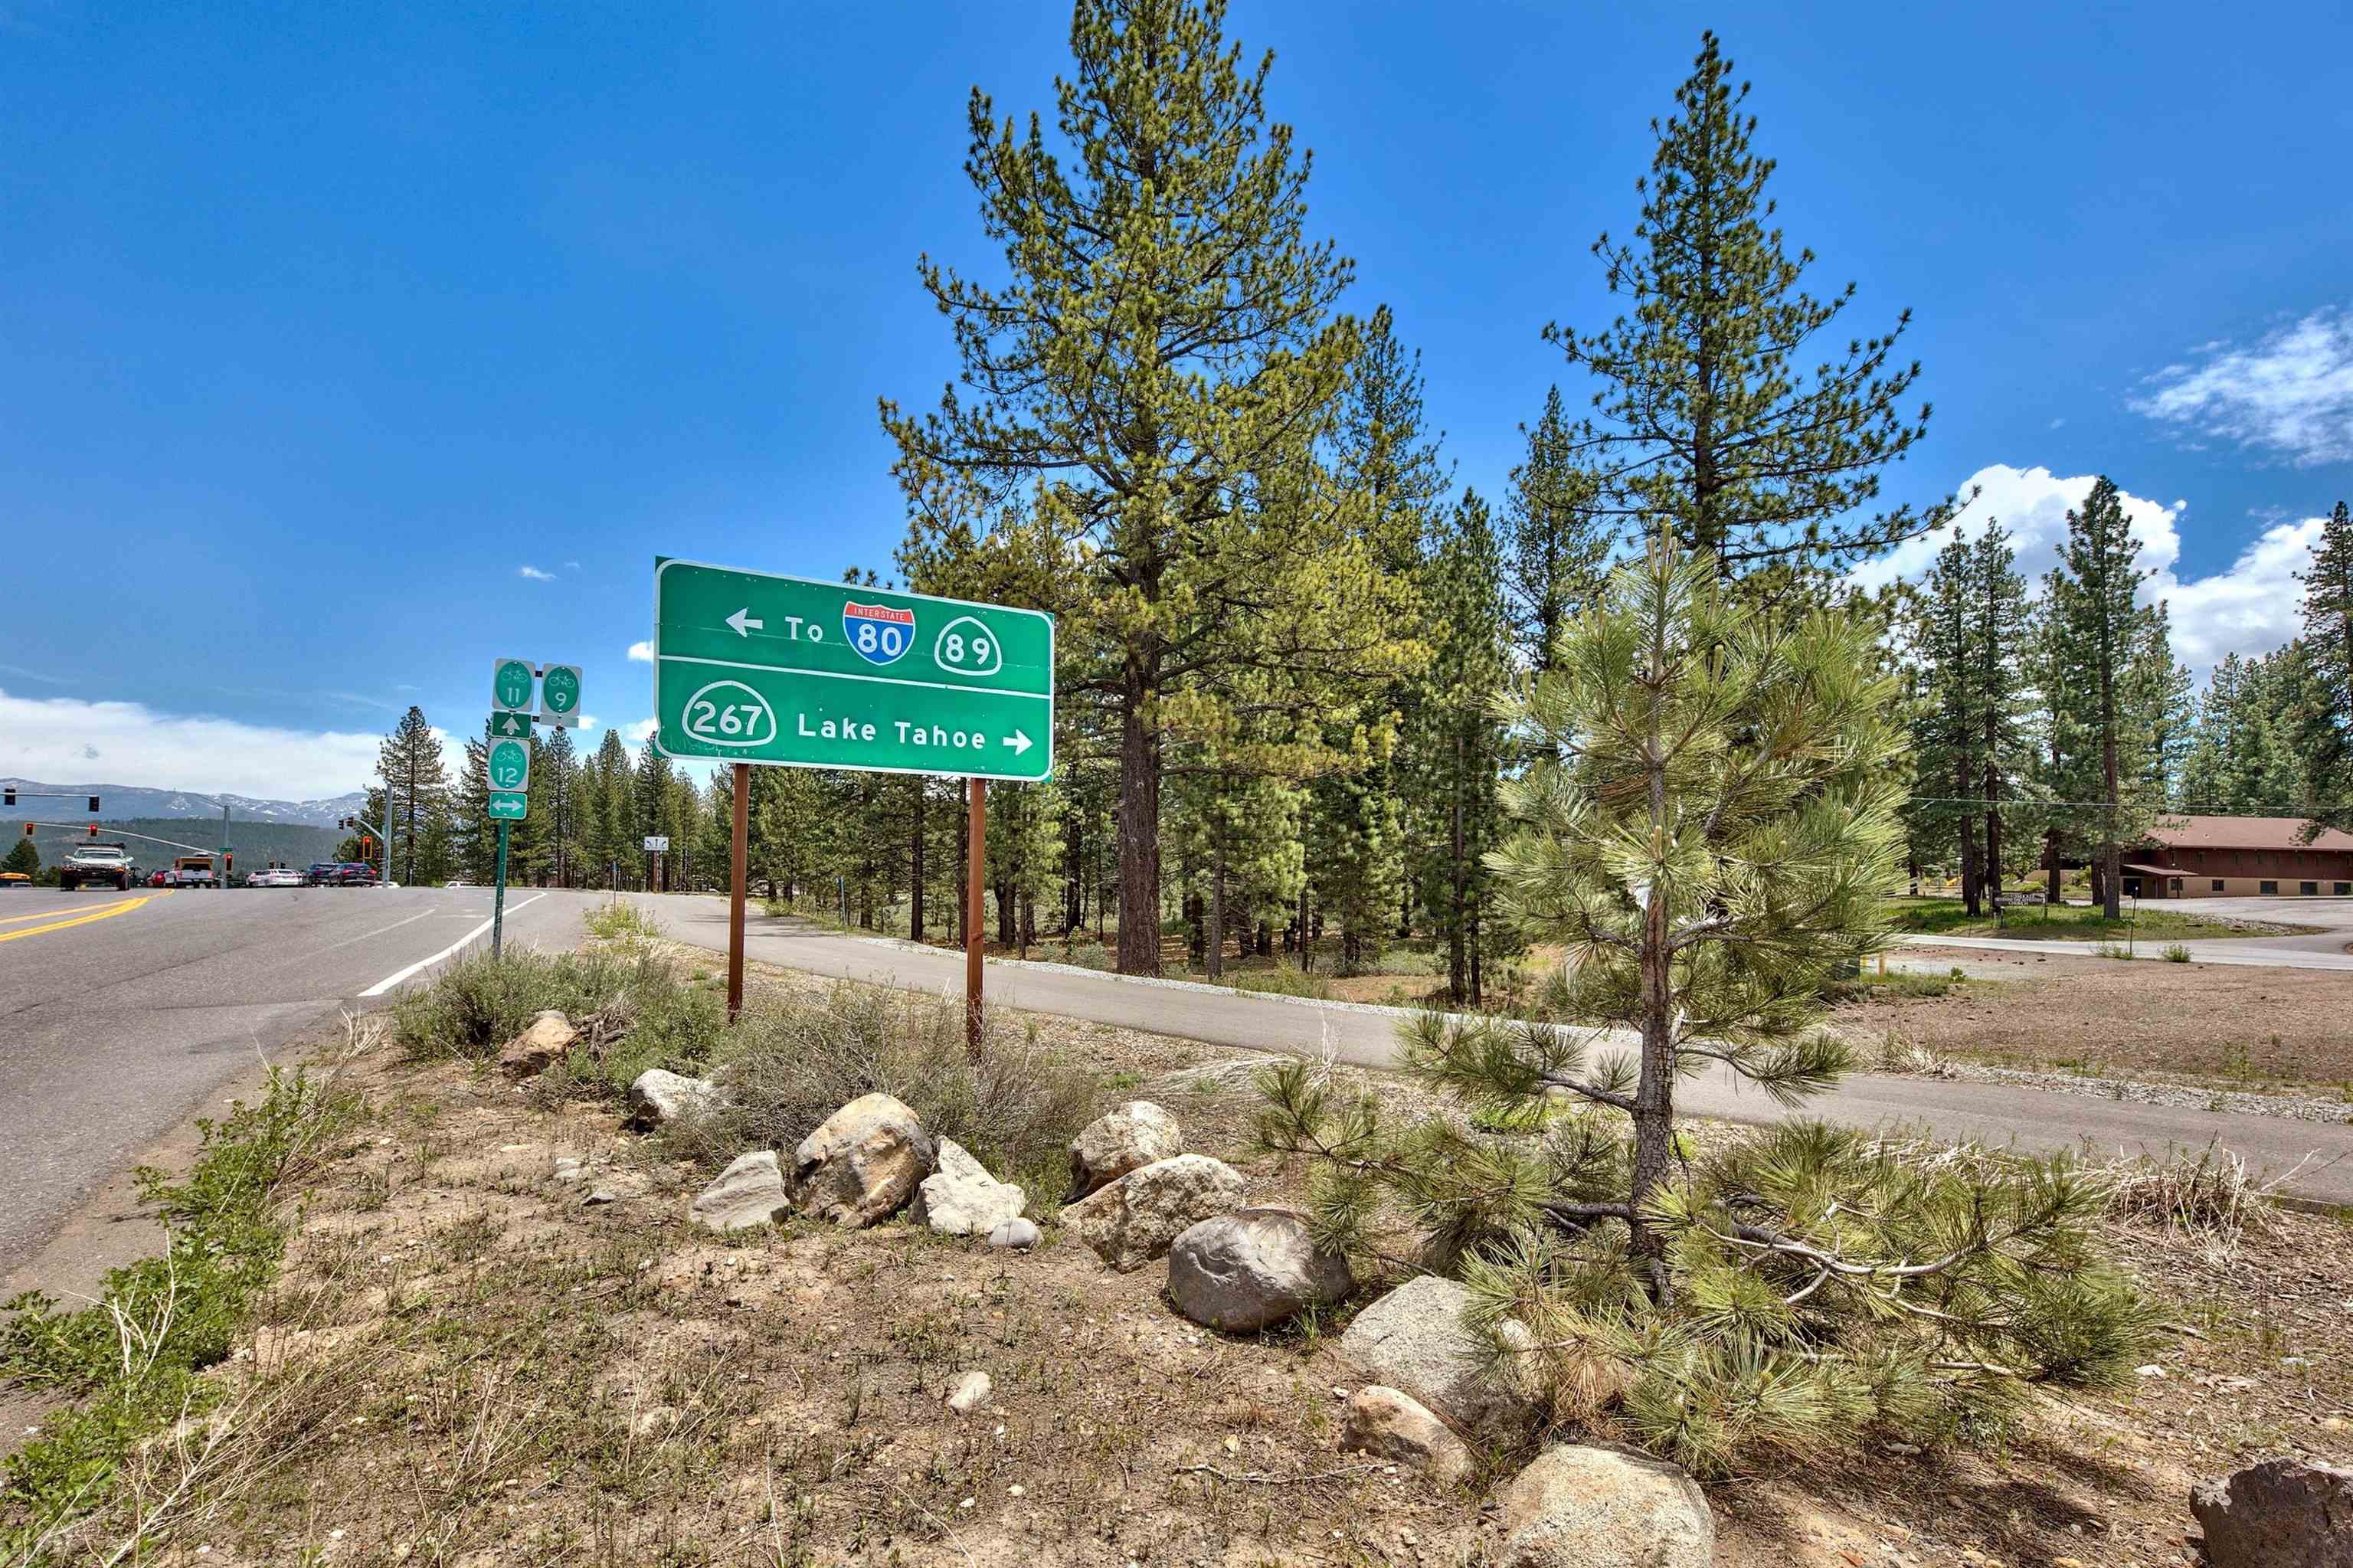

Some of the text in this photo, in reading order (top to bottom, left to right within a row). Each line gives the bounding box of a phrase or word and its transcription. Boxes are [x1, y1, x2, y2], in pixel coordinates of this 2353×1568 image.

[853, 604, 905, 621] INTERSTATE
[785, 616, 823, 643] To
[857, 623, 902, 656] 80
[945, 633, 990, 666] 89
[508, 687, 520, 702] 11
[555, 692, 567, 707] 9
[693, 700, 763, 735] 267
[798, 712, 987, 749] Lake Tahoe
[498, 767, 518, 783] 12
